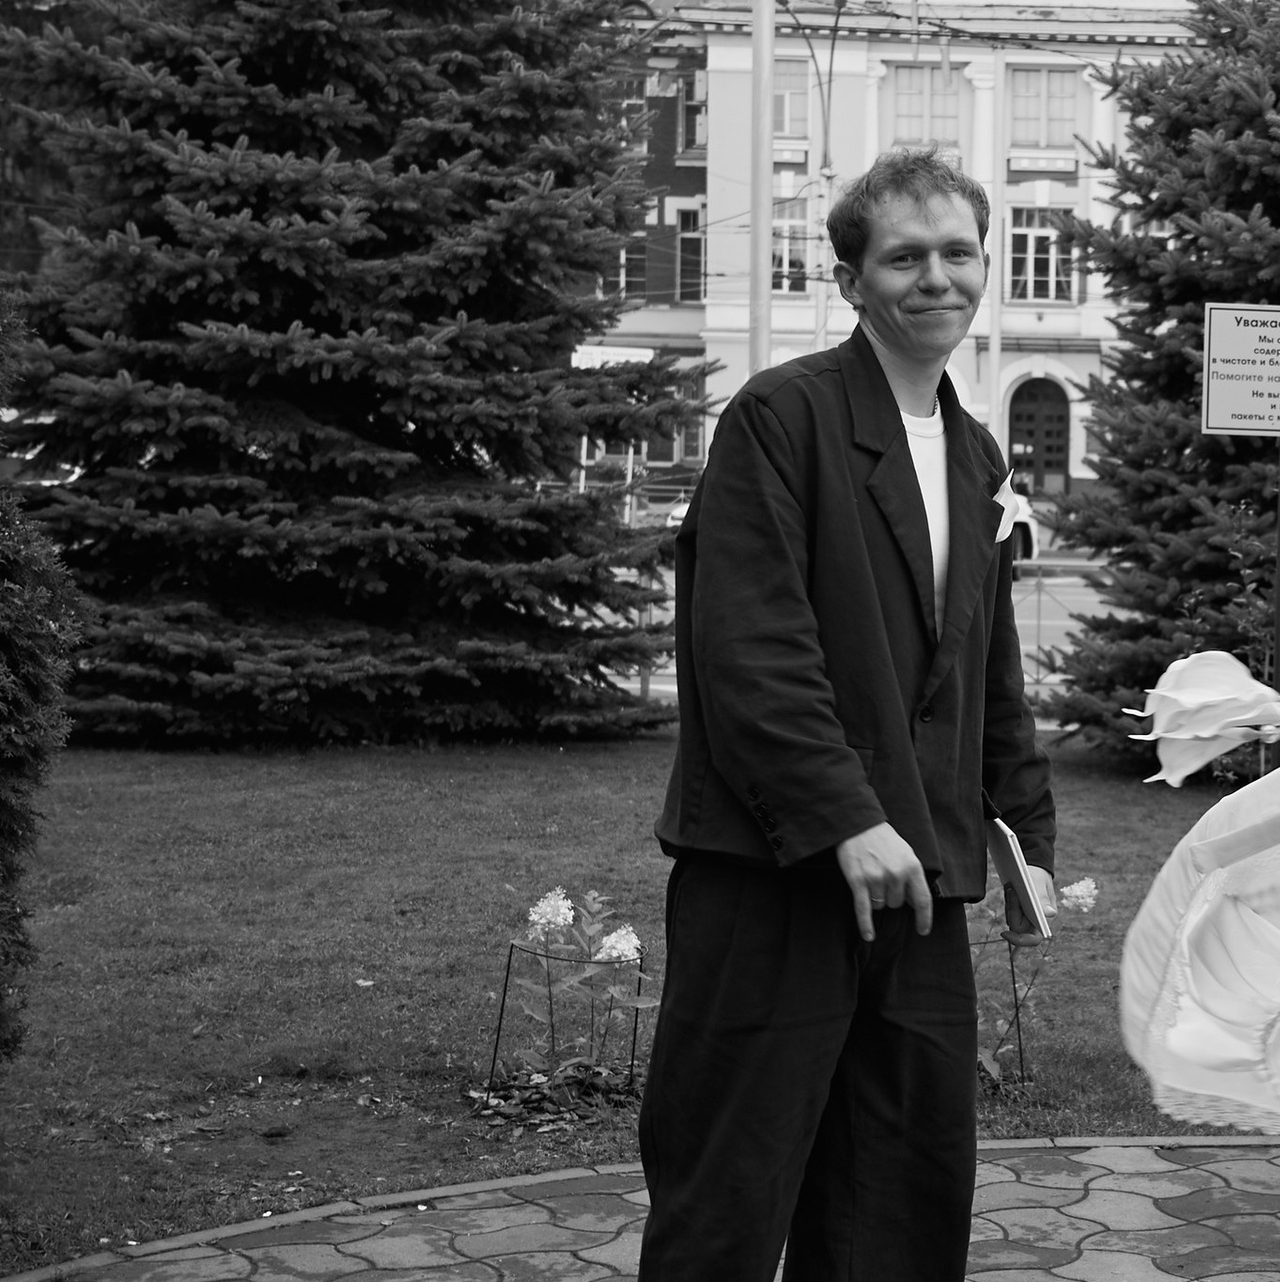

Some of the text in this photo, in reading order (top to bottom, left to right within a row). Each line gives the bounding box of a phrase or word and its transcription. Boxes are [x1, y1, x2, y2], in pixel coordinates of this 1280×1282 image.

[1259, 335, 1274, 343] Мы
[1211, 371, 1263, 382] Помогите
[1252, 390, 1264, 398] Не
